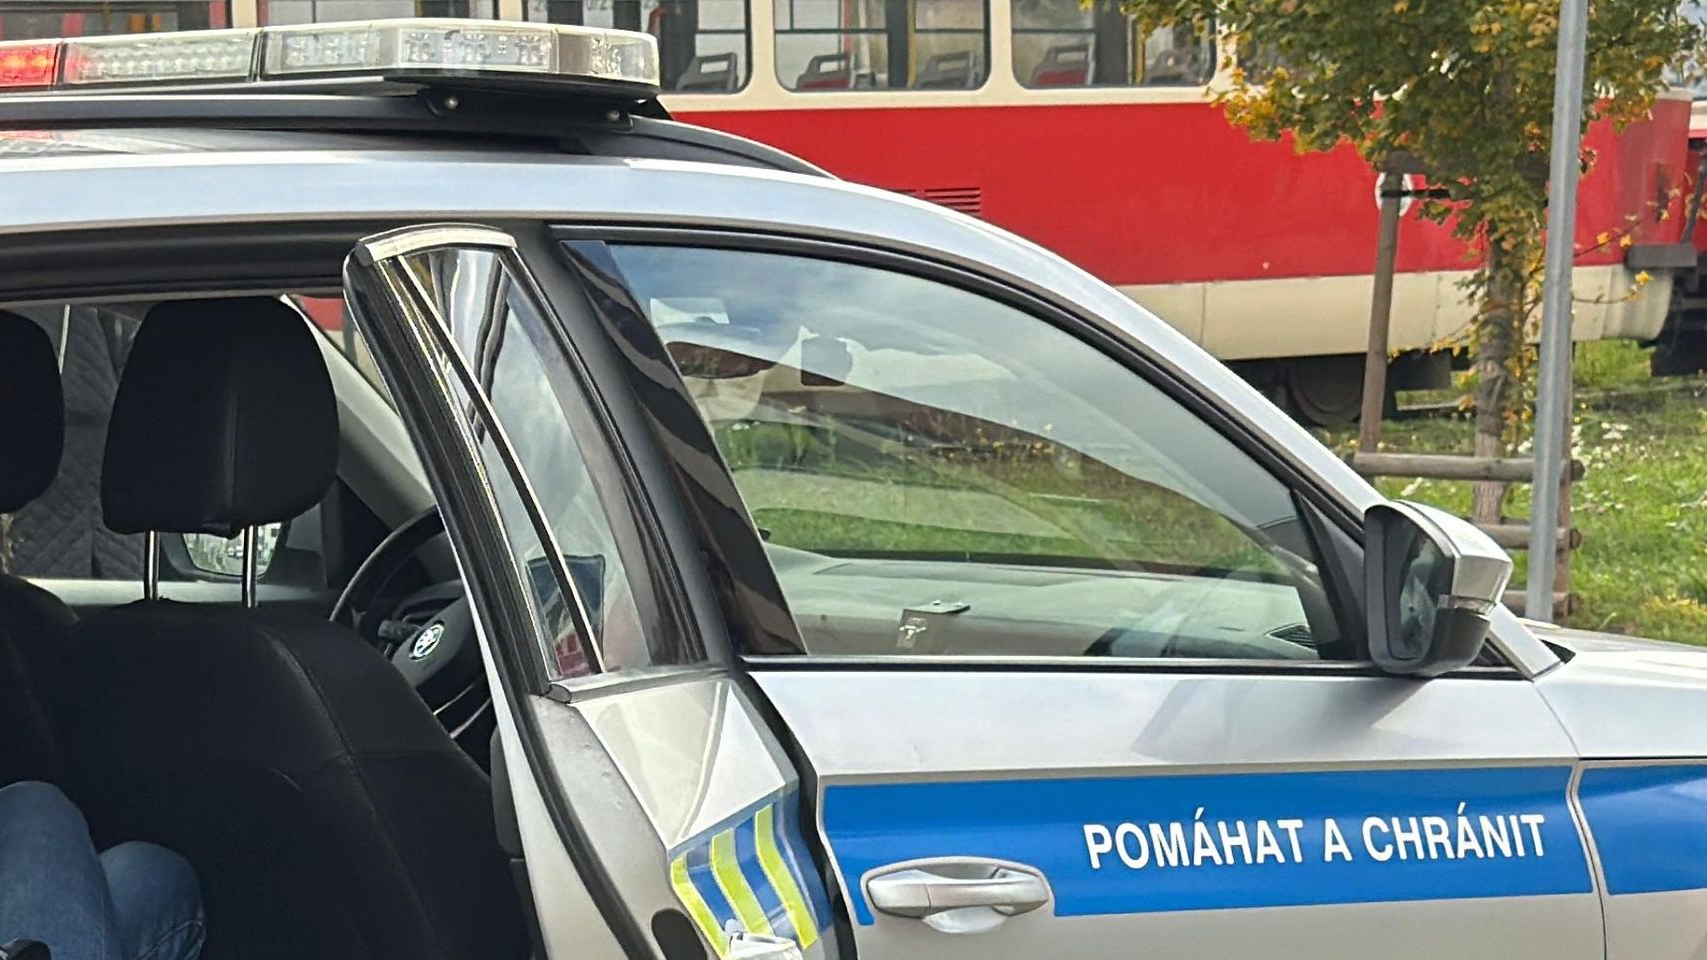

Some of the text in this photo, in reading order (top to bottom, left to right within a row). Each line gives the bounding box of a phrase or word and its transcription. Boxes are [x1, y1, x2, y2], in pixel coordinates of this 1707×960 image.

[1083, 802, 1545, 869] POMÁHAT A CHRÁNIT
